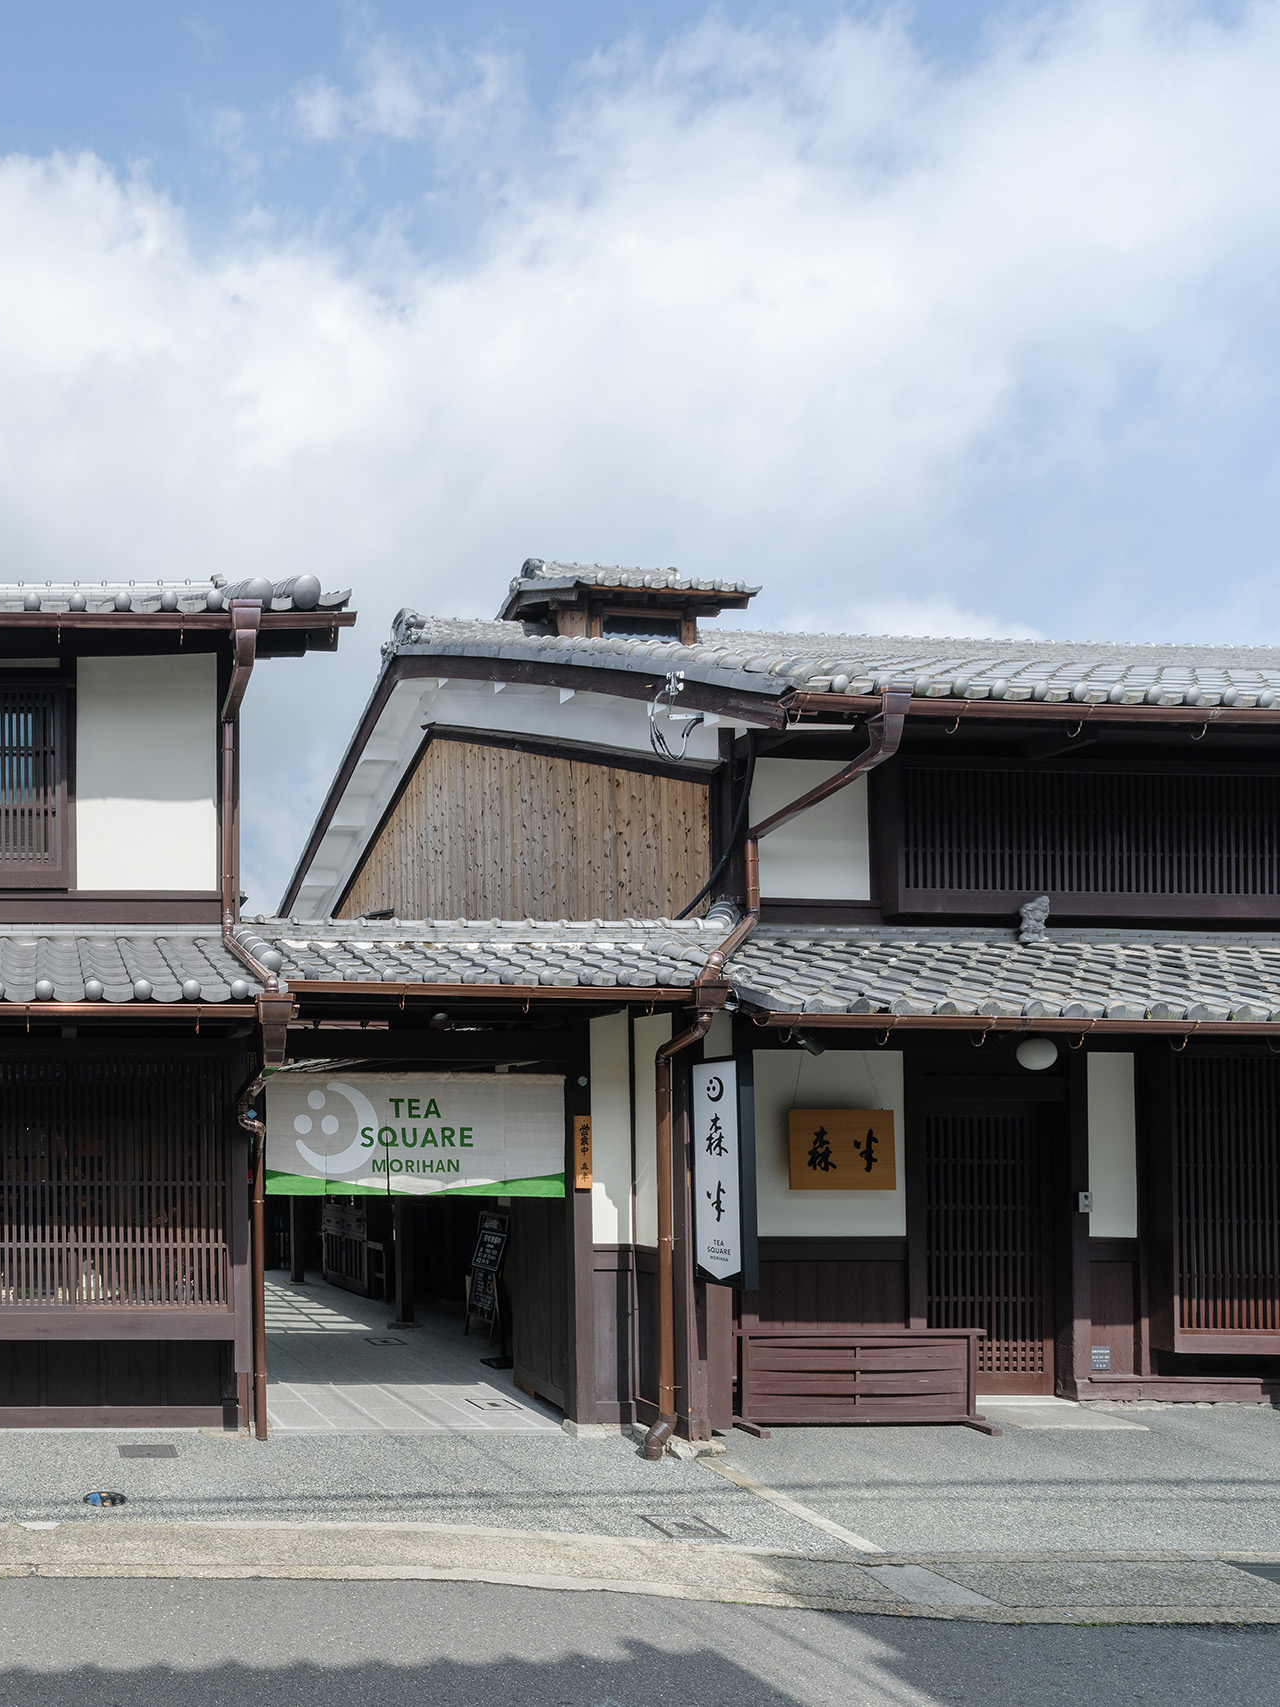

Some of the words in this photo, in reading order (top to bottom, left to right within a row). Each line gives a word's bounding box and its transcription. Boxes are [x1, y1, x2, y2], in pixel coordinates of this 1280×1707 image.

[389, 1098, 442, 1119] TEA
[360, 1127, 474, 1148] SQUARE
[579, 1123, 590, 1157] 営業中
[371, 1159, 460, 1173] MORIHAN
[707, 1246, 731, 1256] SQUARE
[713, 1239, 725, 1247] TEA
